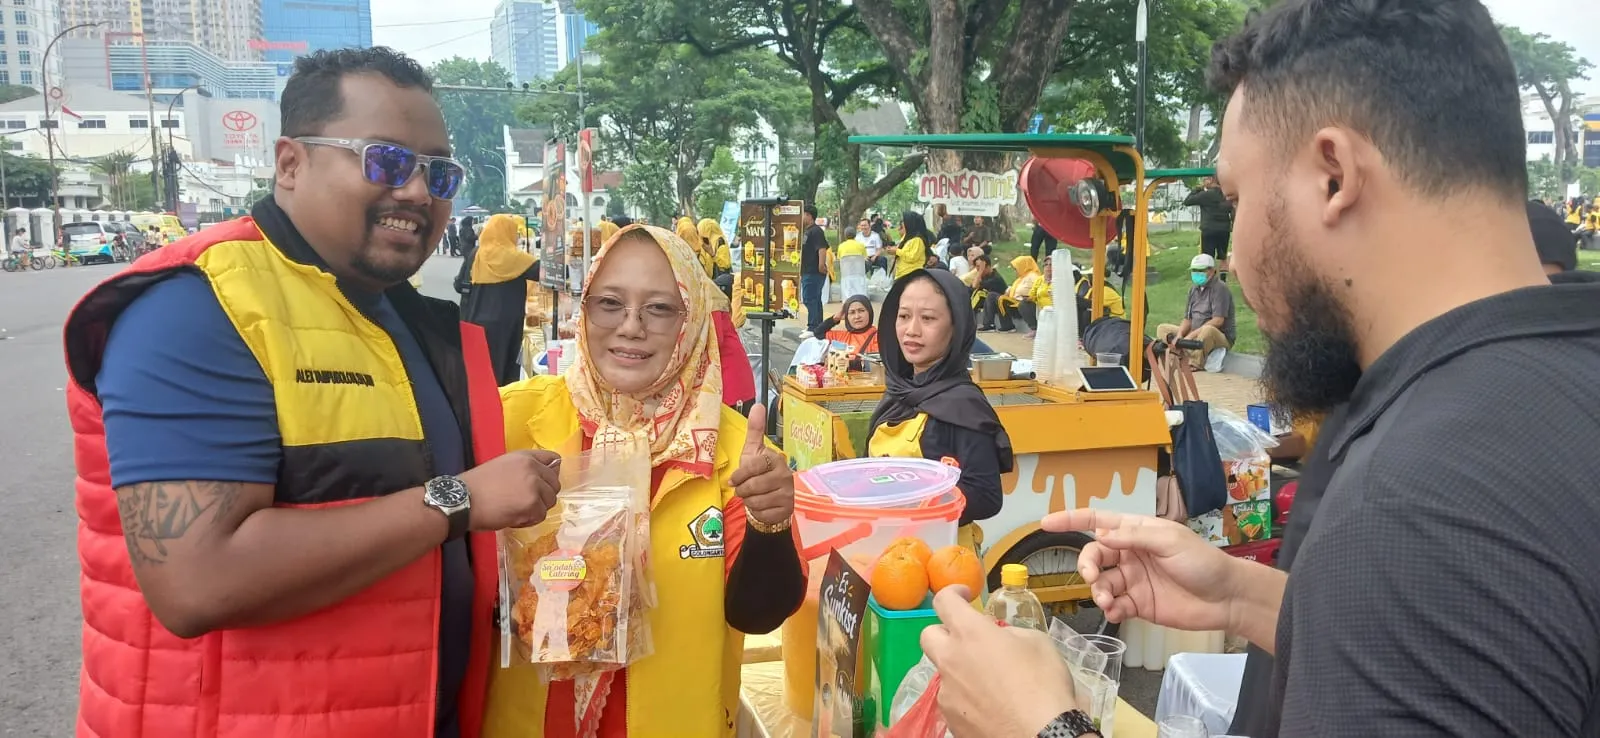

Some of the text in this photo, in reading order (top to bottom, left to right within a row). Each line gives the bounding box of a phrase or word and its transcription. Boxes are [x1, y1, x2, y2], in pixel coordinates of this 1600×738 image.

[920, 172, 1016, 200] MANGO TIME
[838, 571, 849, 594] Es
[824, 584, 857, 640] Sunkist
